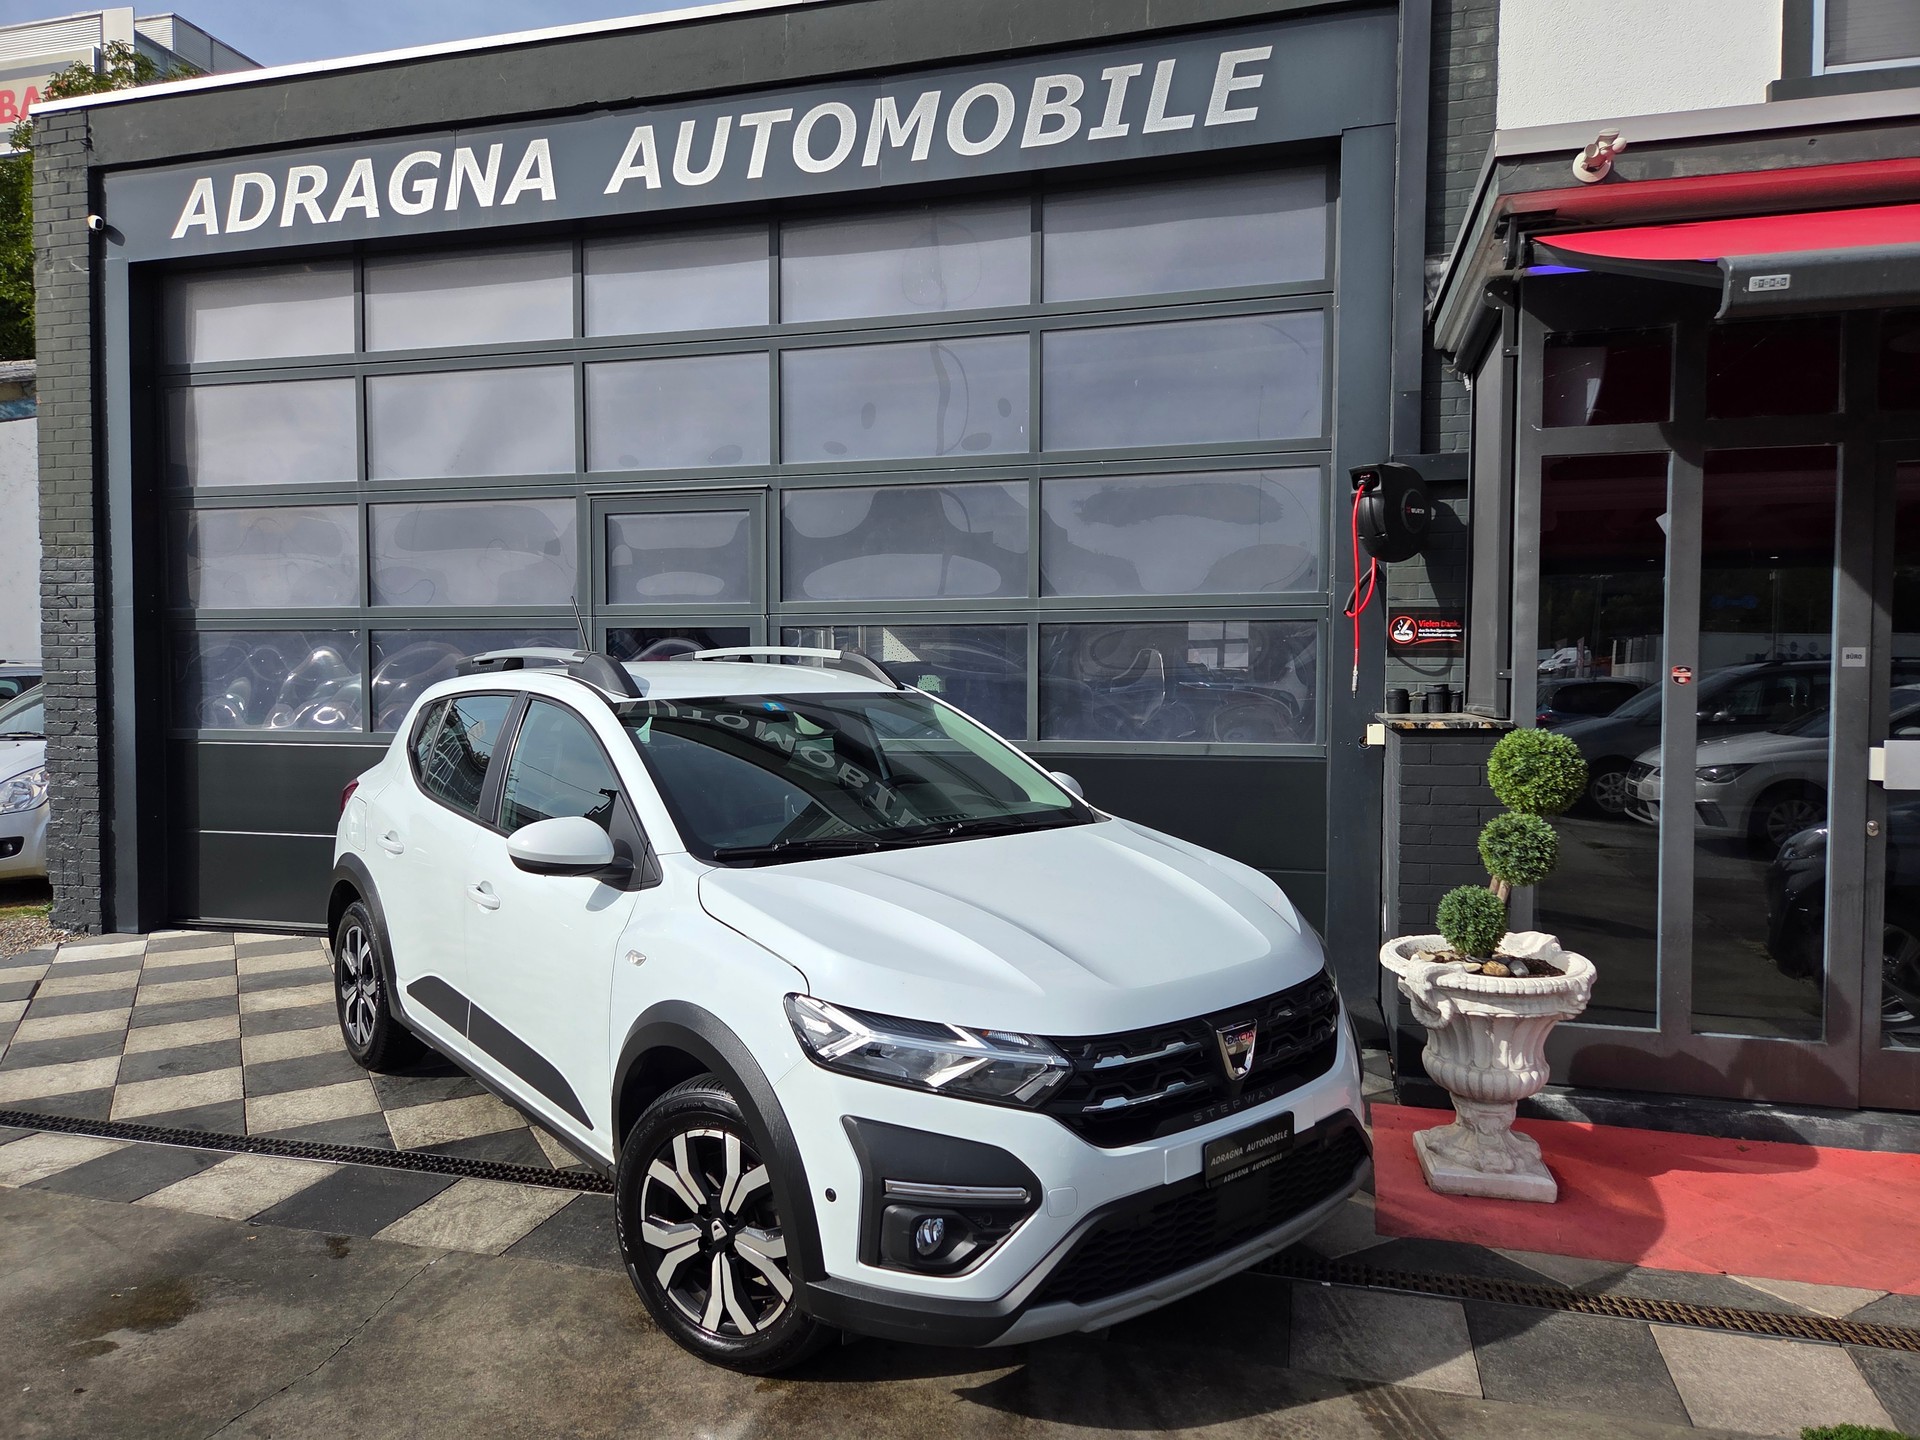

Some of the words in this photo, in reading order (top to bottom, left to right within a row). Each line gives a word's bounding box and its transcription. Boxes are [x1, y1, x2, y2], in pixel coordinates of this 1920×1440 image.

[171, 138, 557, 239] ADRAGNA
[603, 45, 1273, 195] AUTOMOBILE
[1845, 652, 1863, 660] BÜRO
[1226, 1031, 1254, 1045] DACIA
[1194, 1087, 1276, 1122] STEPWAY
[1210, 1147, 1244, 1166] ADRAGNA
[1246, 1129, 1288, 1153] AUTOMOBILE
[1223, 1167, 1249, 1184] ADRAGNA
